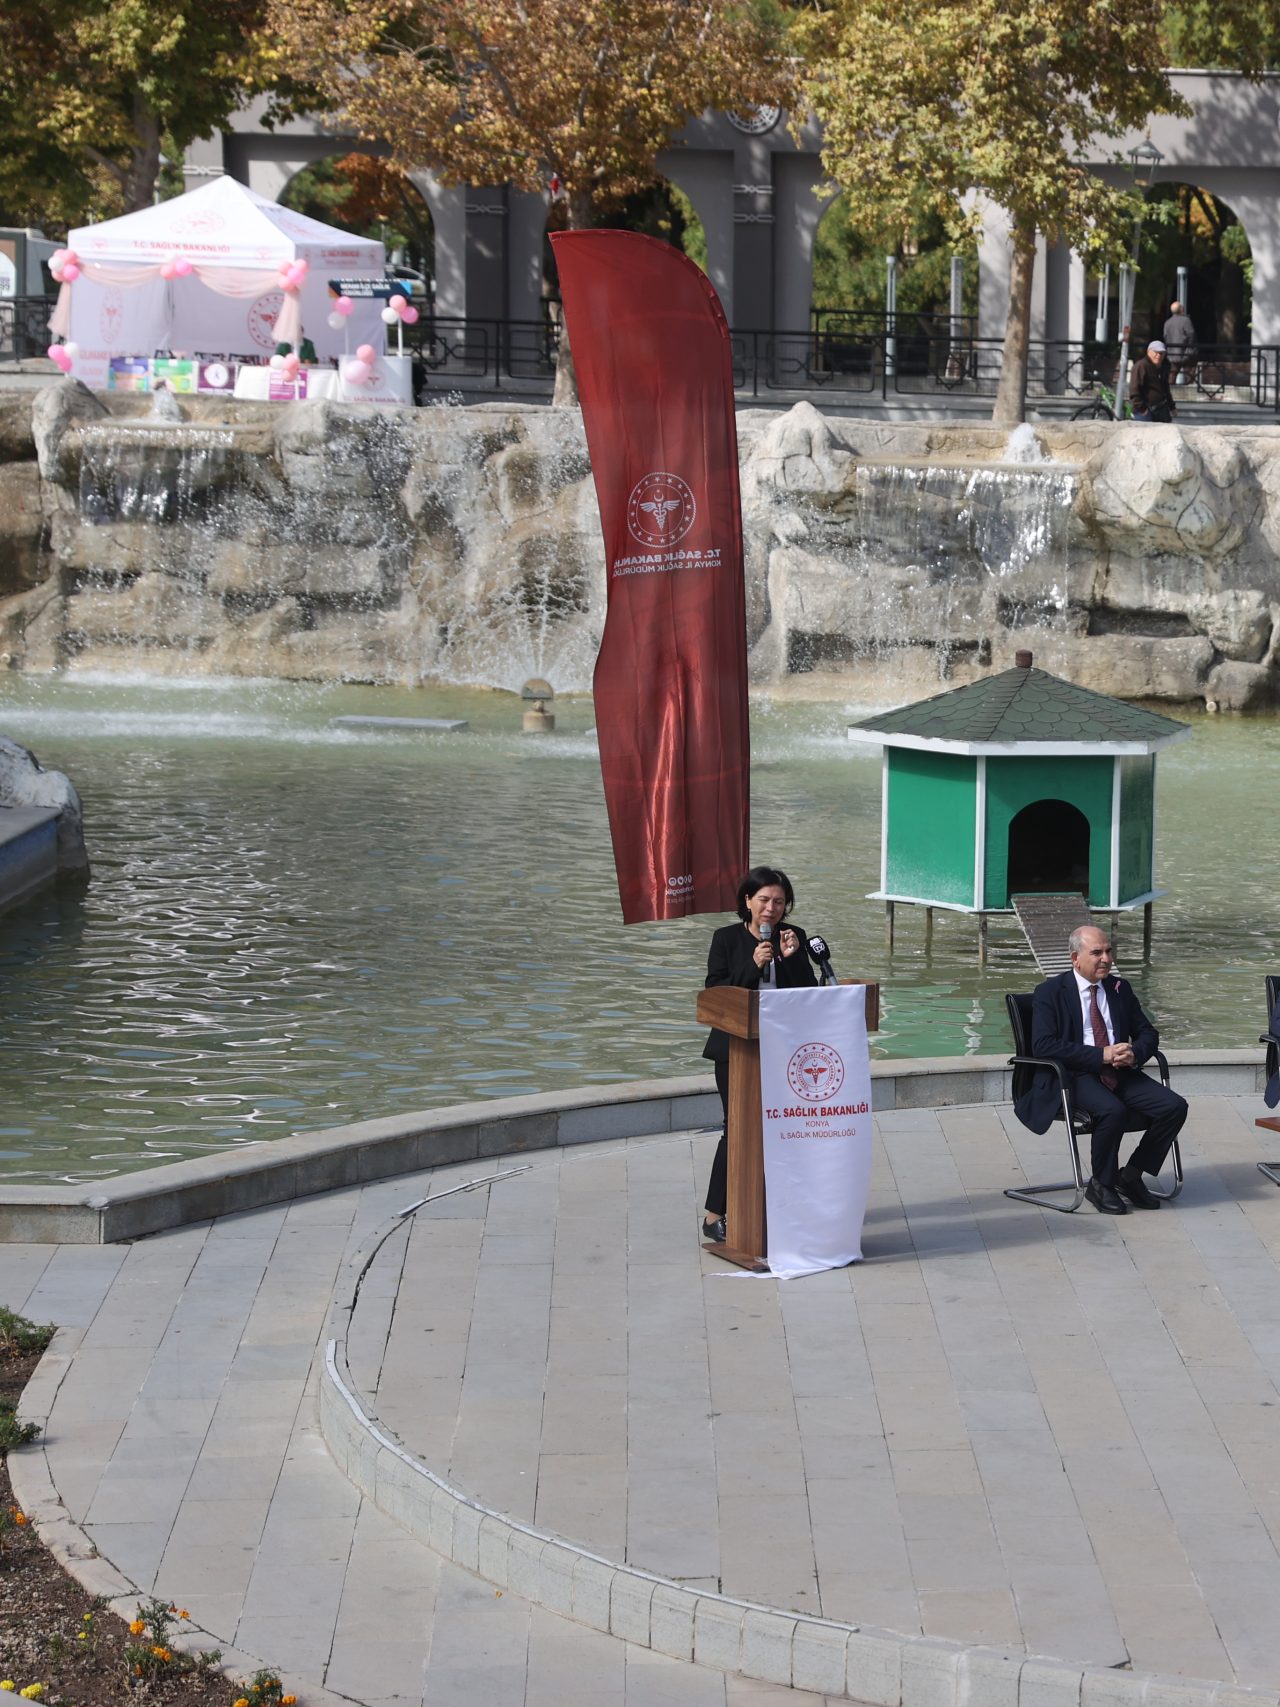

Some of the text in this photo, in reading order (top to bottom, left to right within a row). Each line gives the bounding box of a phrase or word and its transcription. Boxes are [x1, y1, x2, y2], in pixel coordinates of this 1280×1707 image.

[766, 1101, 869, 1119] T.C. SAĞLIK BAKANLIĞI
[787, 1130, 811, 1139] SAĞLIK
[812, 1128, 856, 1138] MÜDÜRLÜĞÜ
